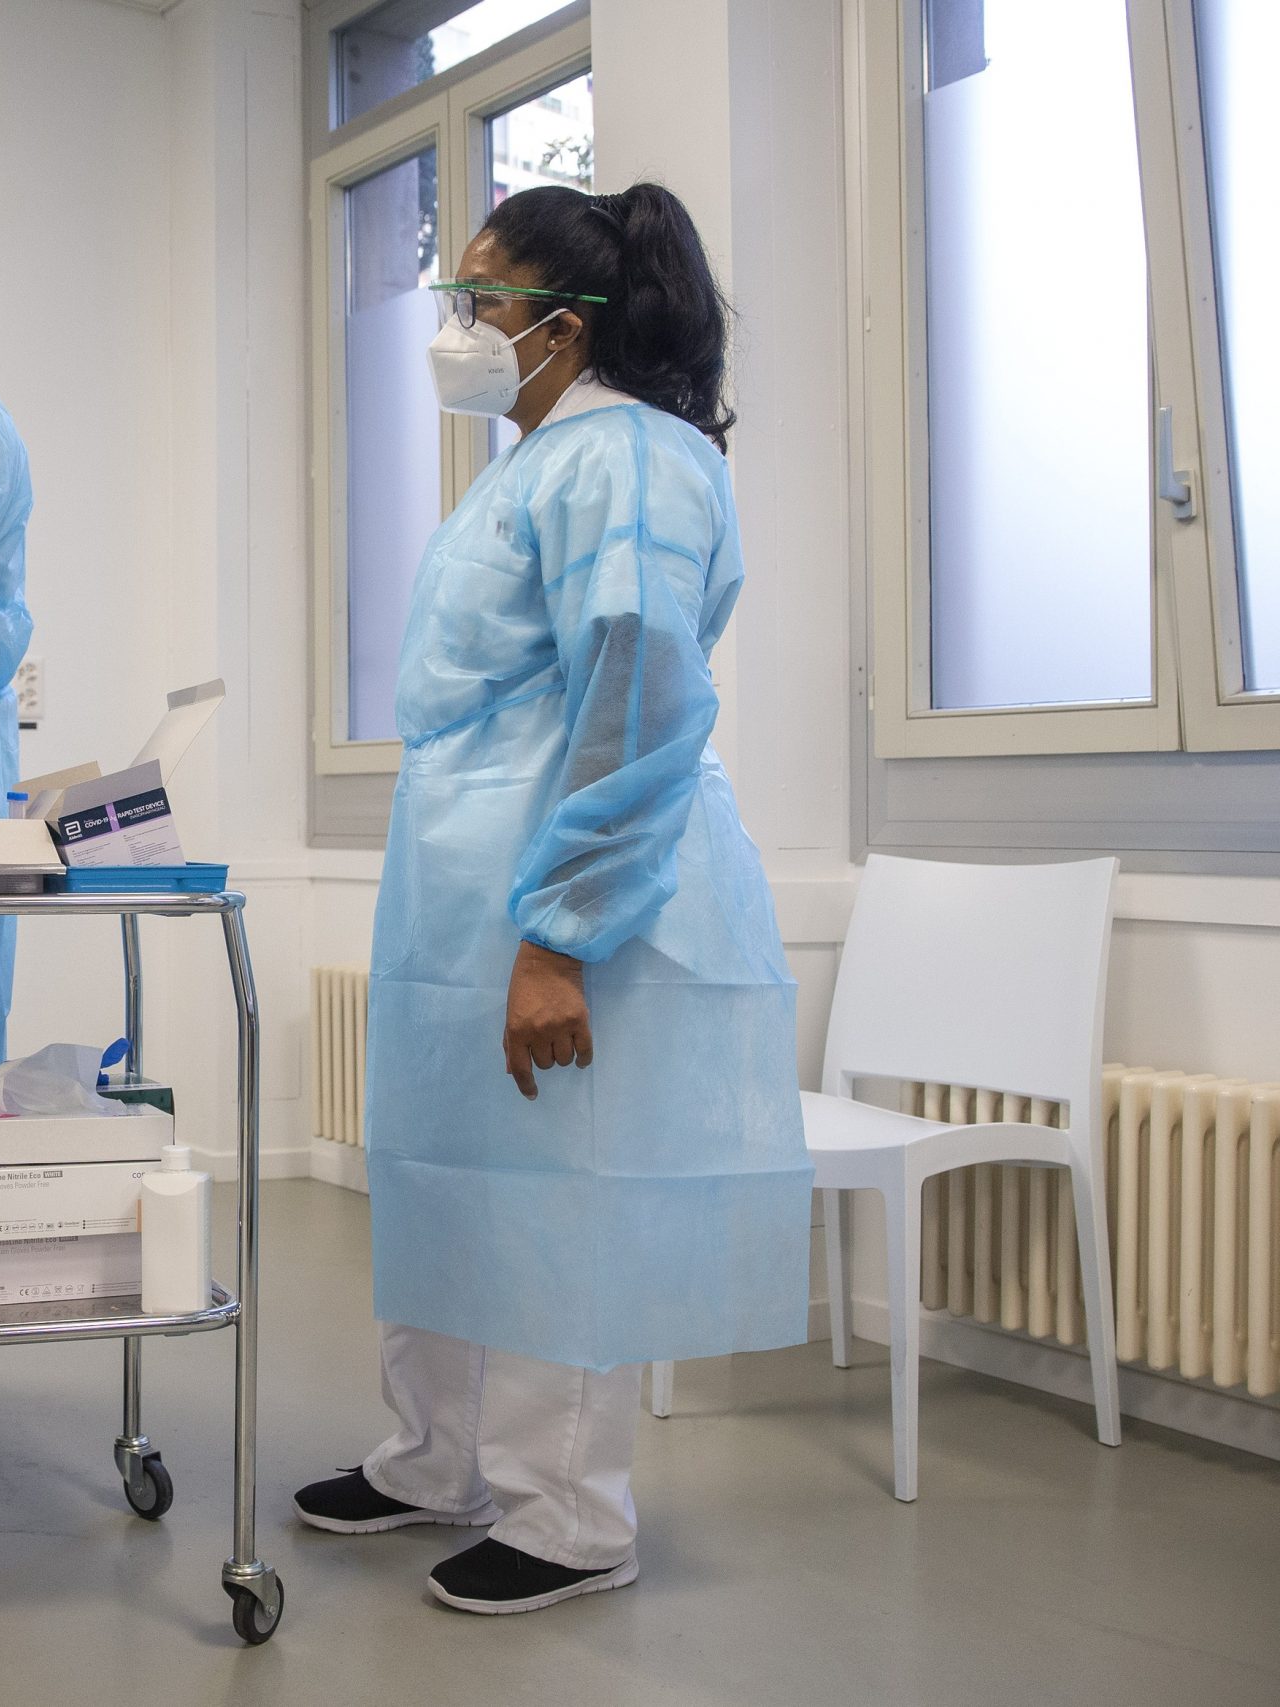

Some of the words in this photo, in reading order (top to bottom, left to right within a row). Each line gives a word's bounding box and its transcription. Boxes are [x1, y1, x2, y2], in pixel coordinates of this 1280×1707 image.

[85, 817, 109, 828] COVID-19
[117, 810, 133, 819] RAPID
[133, 805, 147, 814] TEST
[146, 800, 164, 810] DEVICE
[7, 1173, 28, 1181] Nitrile
